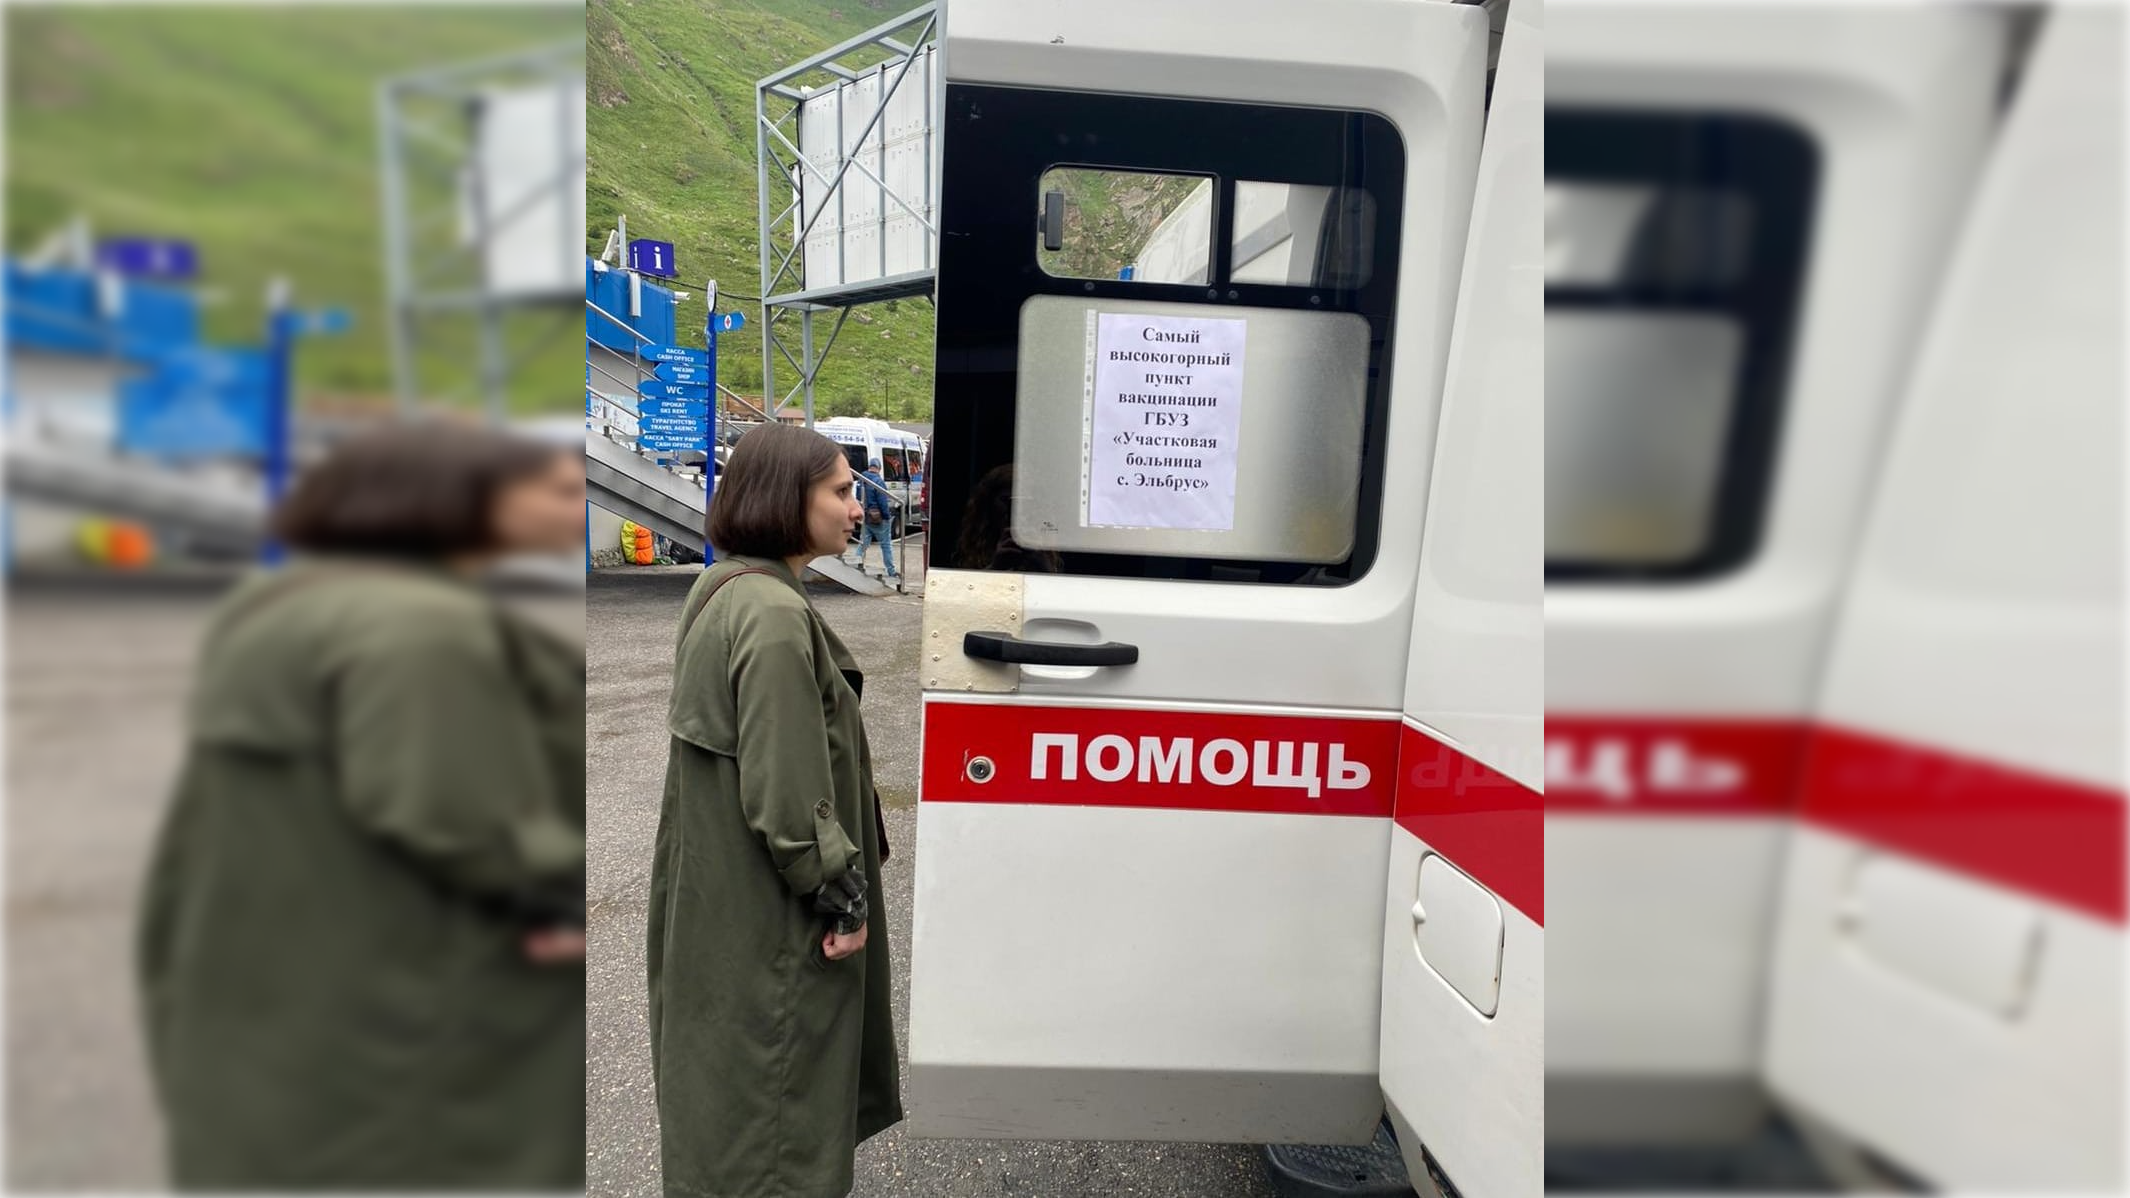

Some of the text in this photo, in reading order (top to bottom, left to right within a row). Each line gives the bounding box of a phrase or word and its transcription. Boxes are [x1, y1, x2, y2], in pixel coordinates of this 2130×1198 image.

[653, 246, 664, 270] i
[1142, 326, 1200, 344] Самый
[673, 355, 695, 363] OFFICE
[1109, 349, 1231, 367] высокогорный
[672, 366, 695, 374] МАГАЗИН
[1144, 372, 1194, 388] пункт
[665, 385, 684, 395] WC
[1118, 392, 1217, 409] вакцинации
[651, 418, 697, 426] ТУРАГЕНТСТВО
[1144, 411, 1189, 427] ГБУЗ
[1113, 431, 1218, 449] «Участковая
[1126, 452, 1202, 470] больница
[1117, 473, 1209, 492] с. Эльбрус»
[1029, 731, 1372, 799] ПОМОЩЬ
